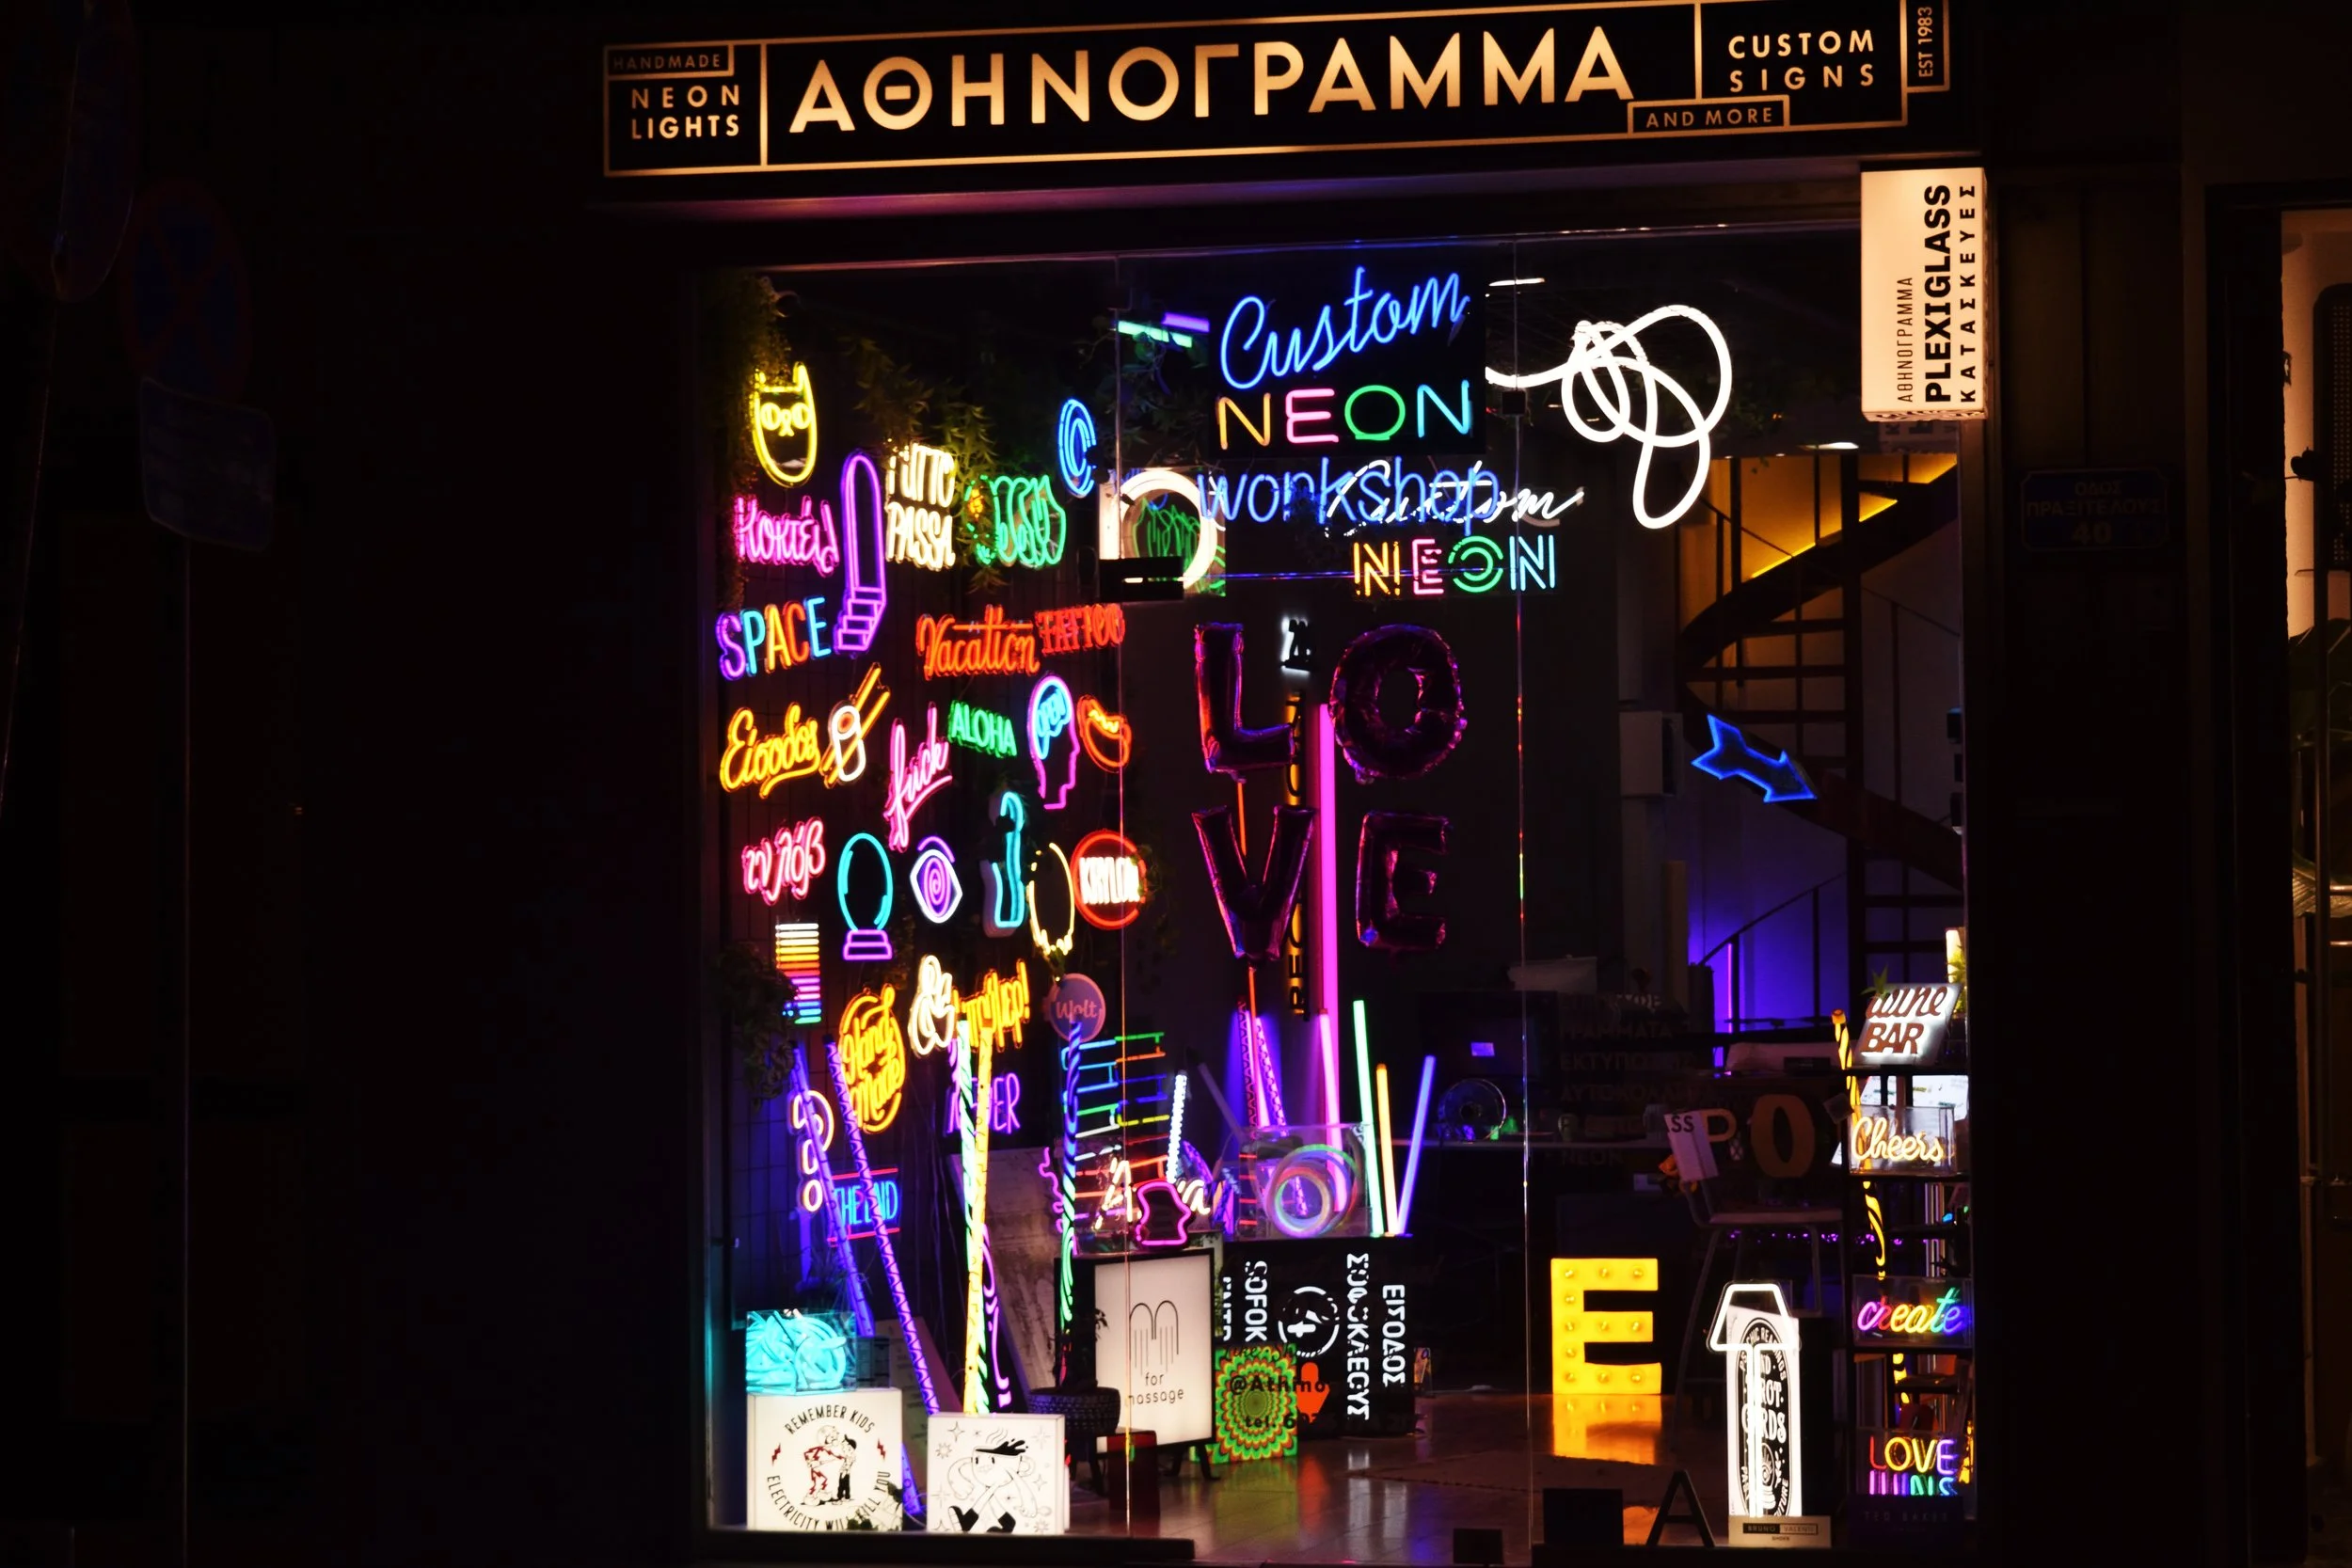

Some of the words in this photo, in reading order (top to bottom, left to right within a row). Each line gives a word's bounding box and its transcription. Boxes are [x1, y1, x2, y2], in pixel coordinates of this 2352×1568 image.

[1728, 29, 1874, 59] CUSTOM
[1917, 7, 1932, 45] 1983
[613, 54, 722, 71] HANDMADE
[788, 25, 1634, 134] ΑΘΗΝΟΓΡΑΜΜΑ
[1729, 63, 1874, 93] SIGNS
[1918, 52, 1933, 77] EST
[631, 85, 740, 109] NEON
[1646, 111, 1694, 128] AND
[1705, 107, 1772, 126] MORE
[631, 114, 740, 139] LIGHTS
[1924, 184, 1951, 403] PLEXIGLASS
[1960, 185, 1976, 403] ΚΑΤΑΣΚΕΥΕΣ
[1220, 265, 1470, 389] Custom
[1897, 277, 1914, 403] ΑΘΗΝΟΓΡΑΜΜΑ
[1217, 380, 1470, 450] NEON
[1195, 456, 1500, 536] workshop
[2074, 481, 2122, 497] ΟΔΟΣ
[2072, 520, 2113, 546] 40
[1352, 535, 1556, 597] NEON
[716, 596, 832, 678] SPACE
[915, 604, 1041, 680] Vacation
[1036, 603, 1126, 655] TATTOO
[948, 700, 1018, 758] ALOHA
[882, 702, 953, 853] fuck
[1056, 1000, 1097, 1020] Wolt
[1860, 1022, 1925, 1054] BAR
[1851, 1116, 1946, 1163] Cheers
[1550, 1258, 1661, 1395] E
[1857, 1287, 1965, 1334] create
[1145, 1371, 1165, 1386] for
[785, 1404, 847, 1434] REMEMBER
[850, 1410, 875, 1433] KIDS
[1740, 1403, 1787, 1443] CRDS
[1869, 1435, 1959, 1476] LOVE
[767, 1475, 819, 1530] ELECTRICITY
[873, 1471, 891, 1494] YOU
